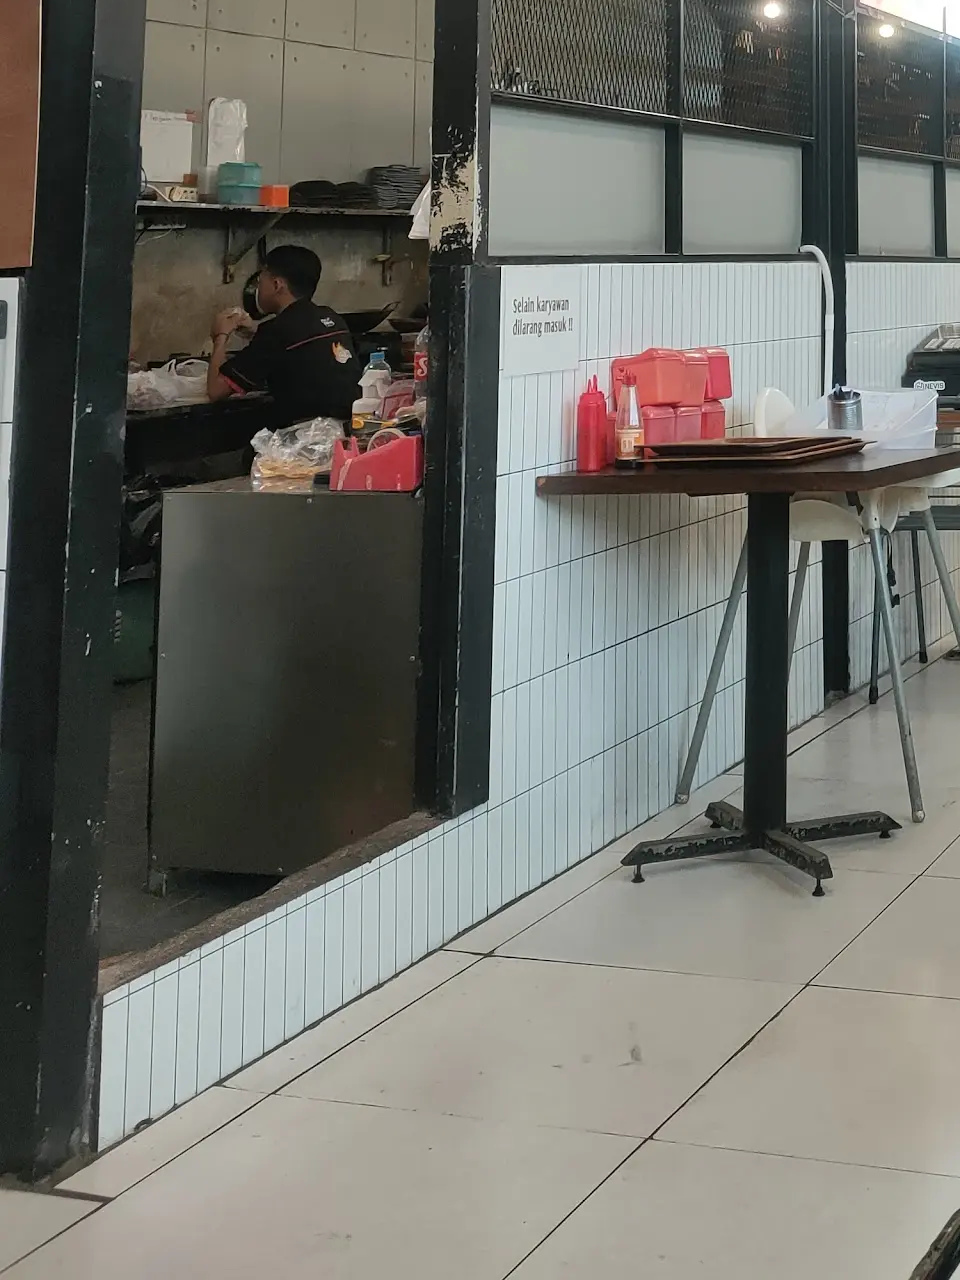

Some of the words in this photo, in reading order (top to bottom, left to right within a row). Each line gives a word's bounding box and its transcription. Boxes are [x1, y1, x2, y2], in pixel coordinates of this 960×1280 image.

[513, 297, 534, 313] Selain
[536, 295, 570, 316] karyawan
[512, 318, 542, 338] dilarang
[544, 316, 567, 333] masuk
[924, 382, 944, 390] NEVIS
